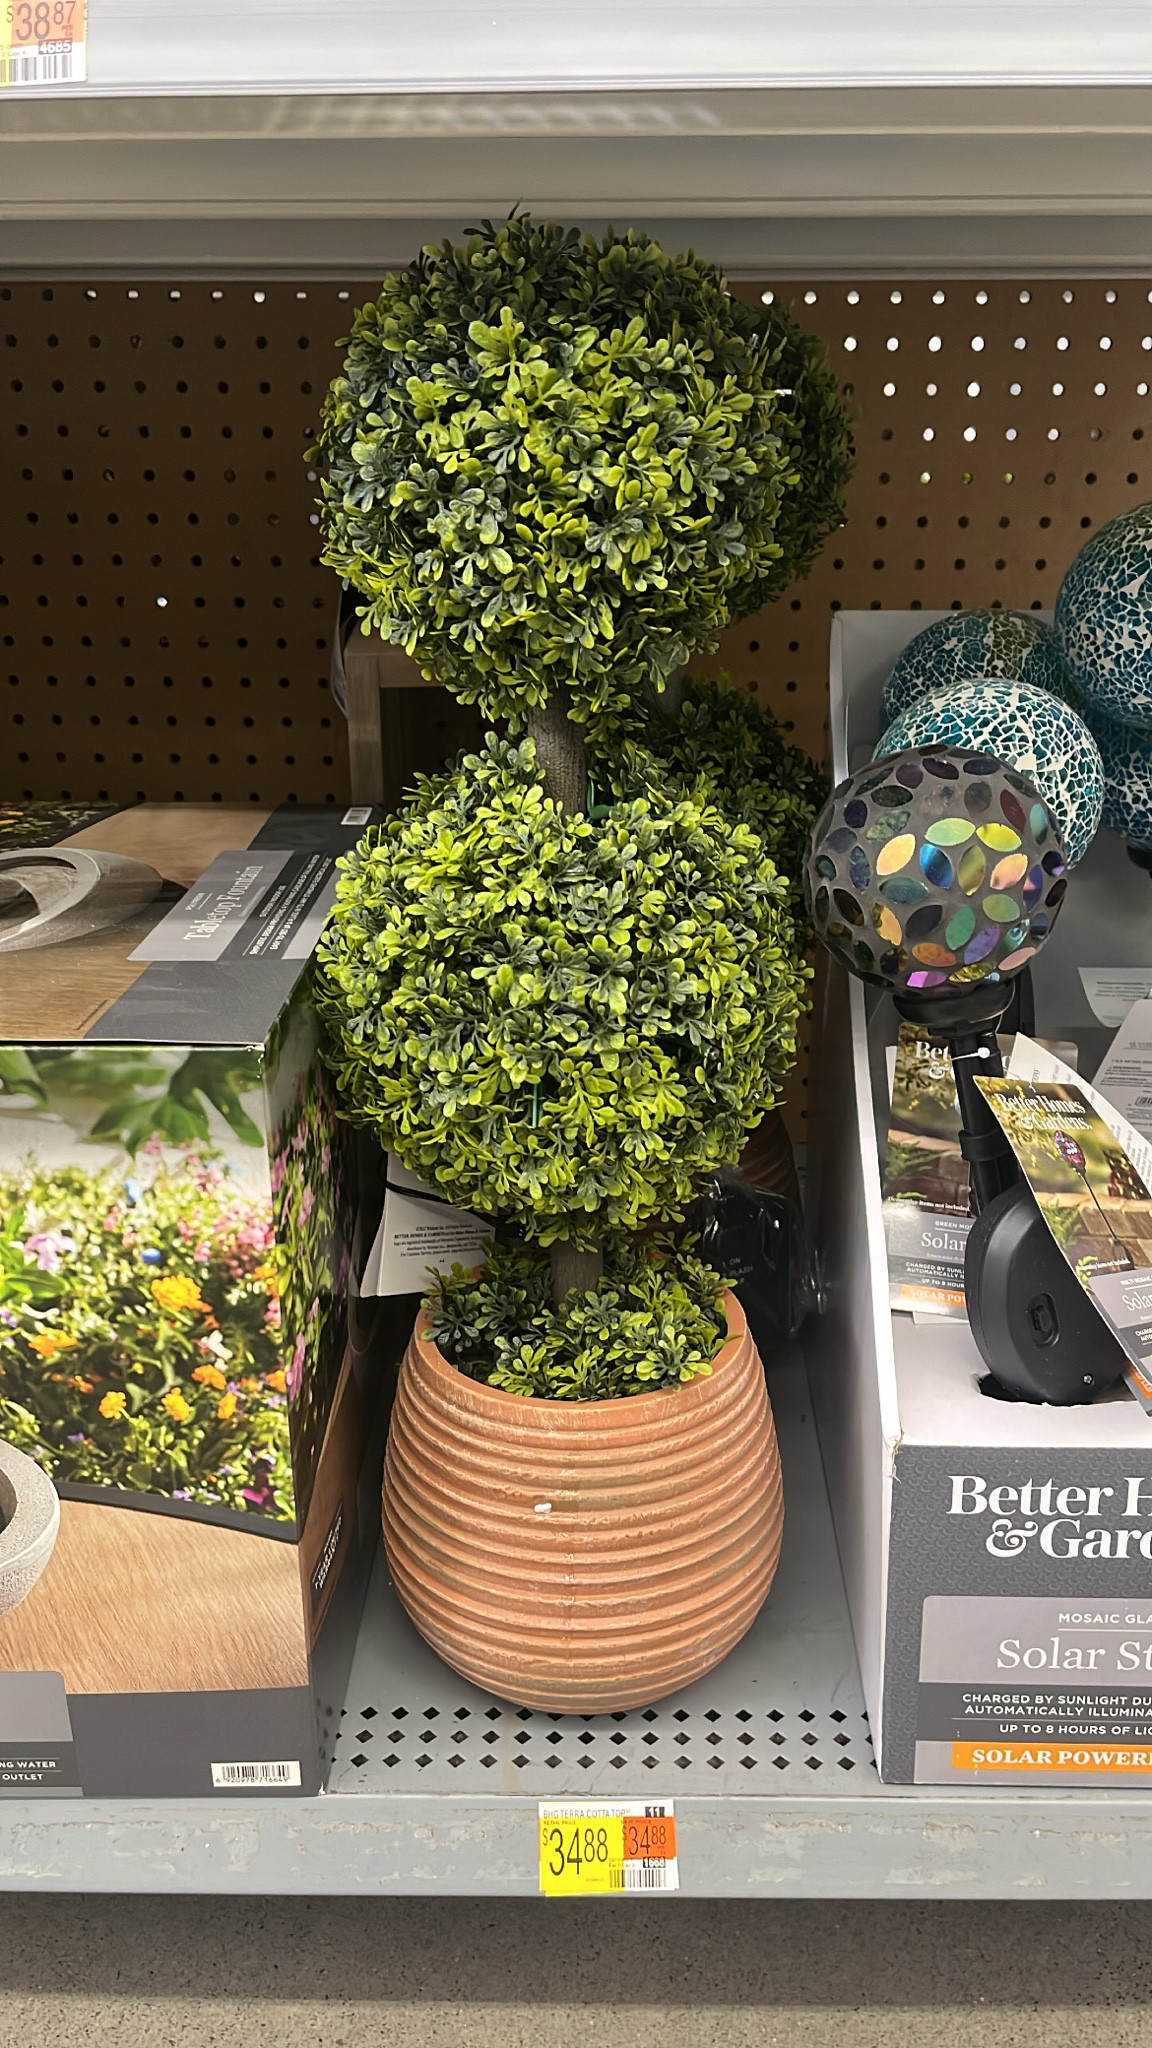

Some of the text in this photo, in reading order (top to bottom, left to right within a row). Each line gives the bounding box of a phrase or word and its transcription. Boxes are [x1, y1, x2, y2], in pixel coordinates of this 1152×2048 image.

[40, 41, 72, 53] 4685
[183, 902, 242, 940] Tabletop
[216, 866, 263, 900] Fountain
[994, 1093, 1086, 1113] Better Homes
[905, 1261, 935, 1270] CHARGED
[946, 1475, 1114, 1516] Better
[1058, 1613, 1120, 1623] MOSAIC
[997, 1637, 1106, 1669] Solar
[962, 1694, 1031, 1704] CHARGED
[1035, 1695, 1054, 1704] BY
[1057, 1695, 1128, 1706] SUNLIGHT
[965, 1705, 1084, 1716] AUTOMATICALLY
[1000, 1725, 1018, 1733] UP
[1023, 1725, 1041, 1734] TO
[1046, 1725, 1054, 1734] 8
[1059, 1726, 1107, 1735] HOURS
[1111, 1726, 1131, 1735] OF
[972, 1749, 1052, 1764] SOLAR
[544, 1809, 559, 1819] BHG
[560, 1809, 584, 1818] TERRA
[587, 1808, 610, 1818] COTTA
